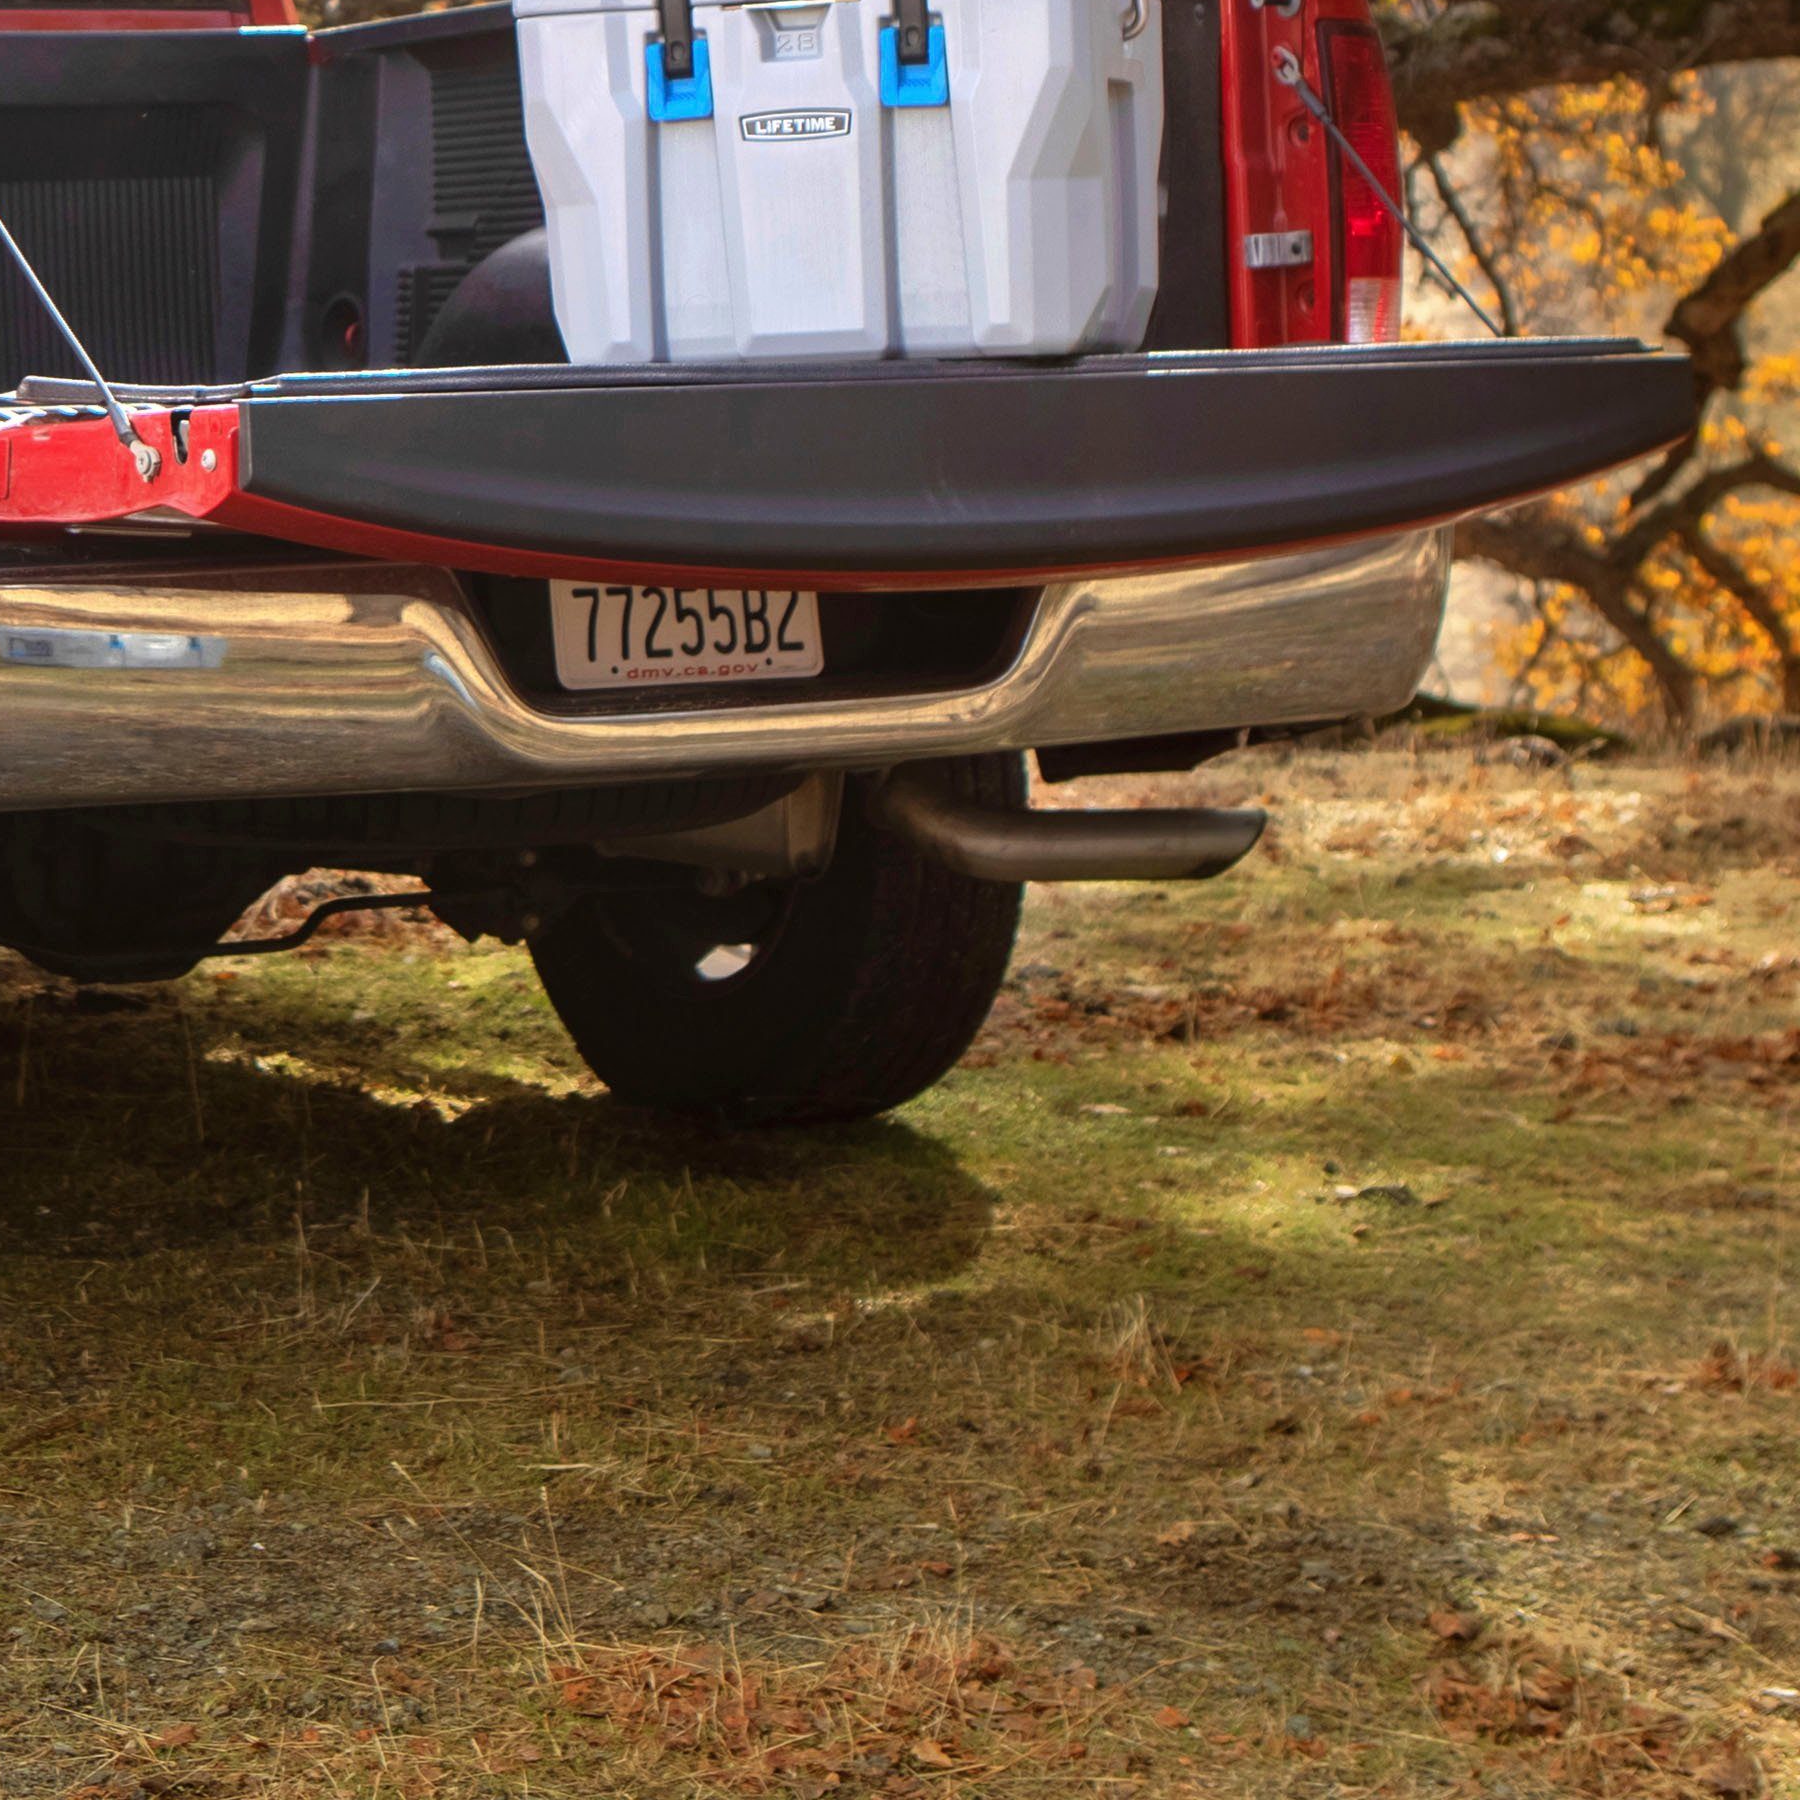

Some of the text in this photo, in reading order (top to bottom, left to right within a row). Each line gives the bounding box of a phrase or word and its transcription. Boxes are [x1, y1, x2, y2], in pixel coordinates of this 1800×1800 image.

[755, 117, 836, 134] LIFETIME
[571, 587, 805, 662] 77255B2
[627, 663, 758, 680] dmv.ca.gov
